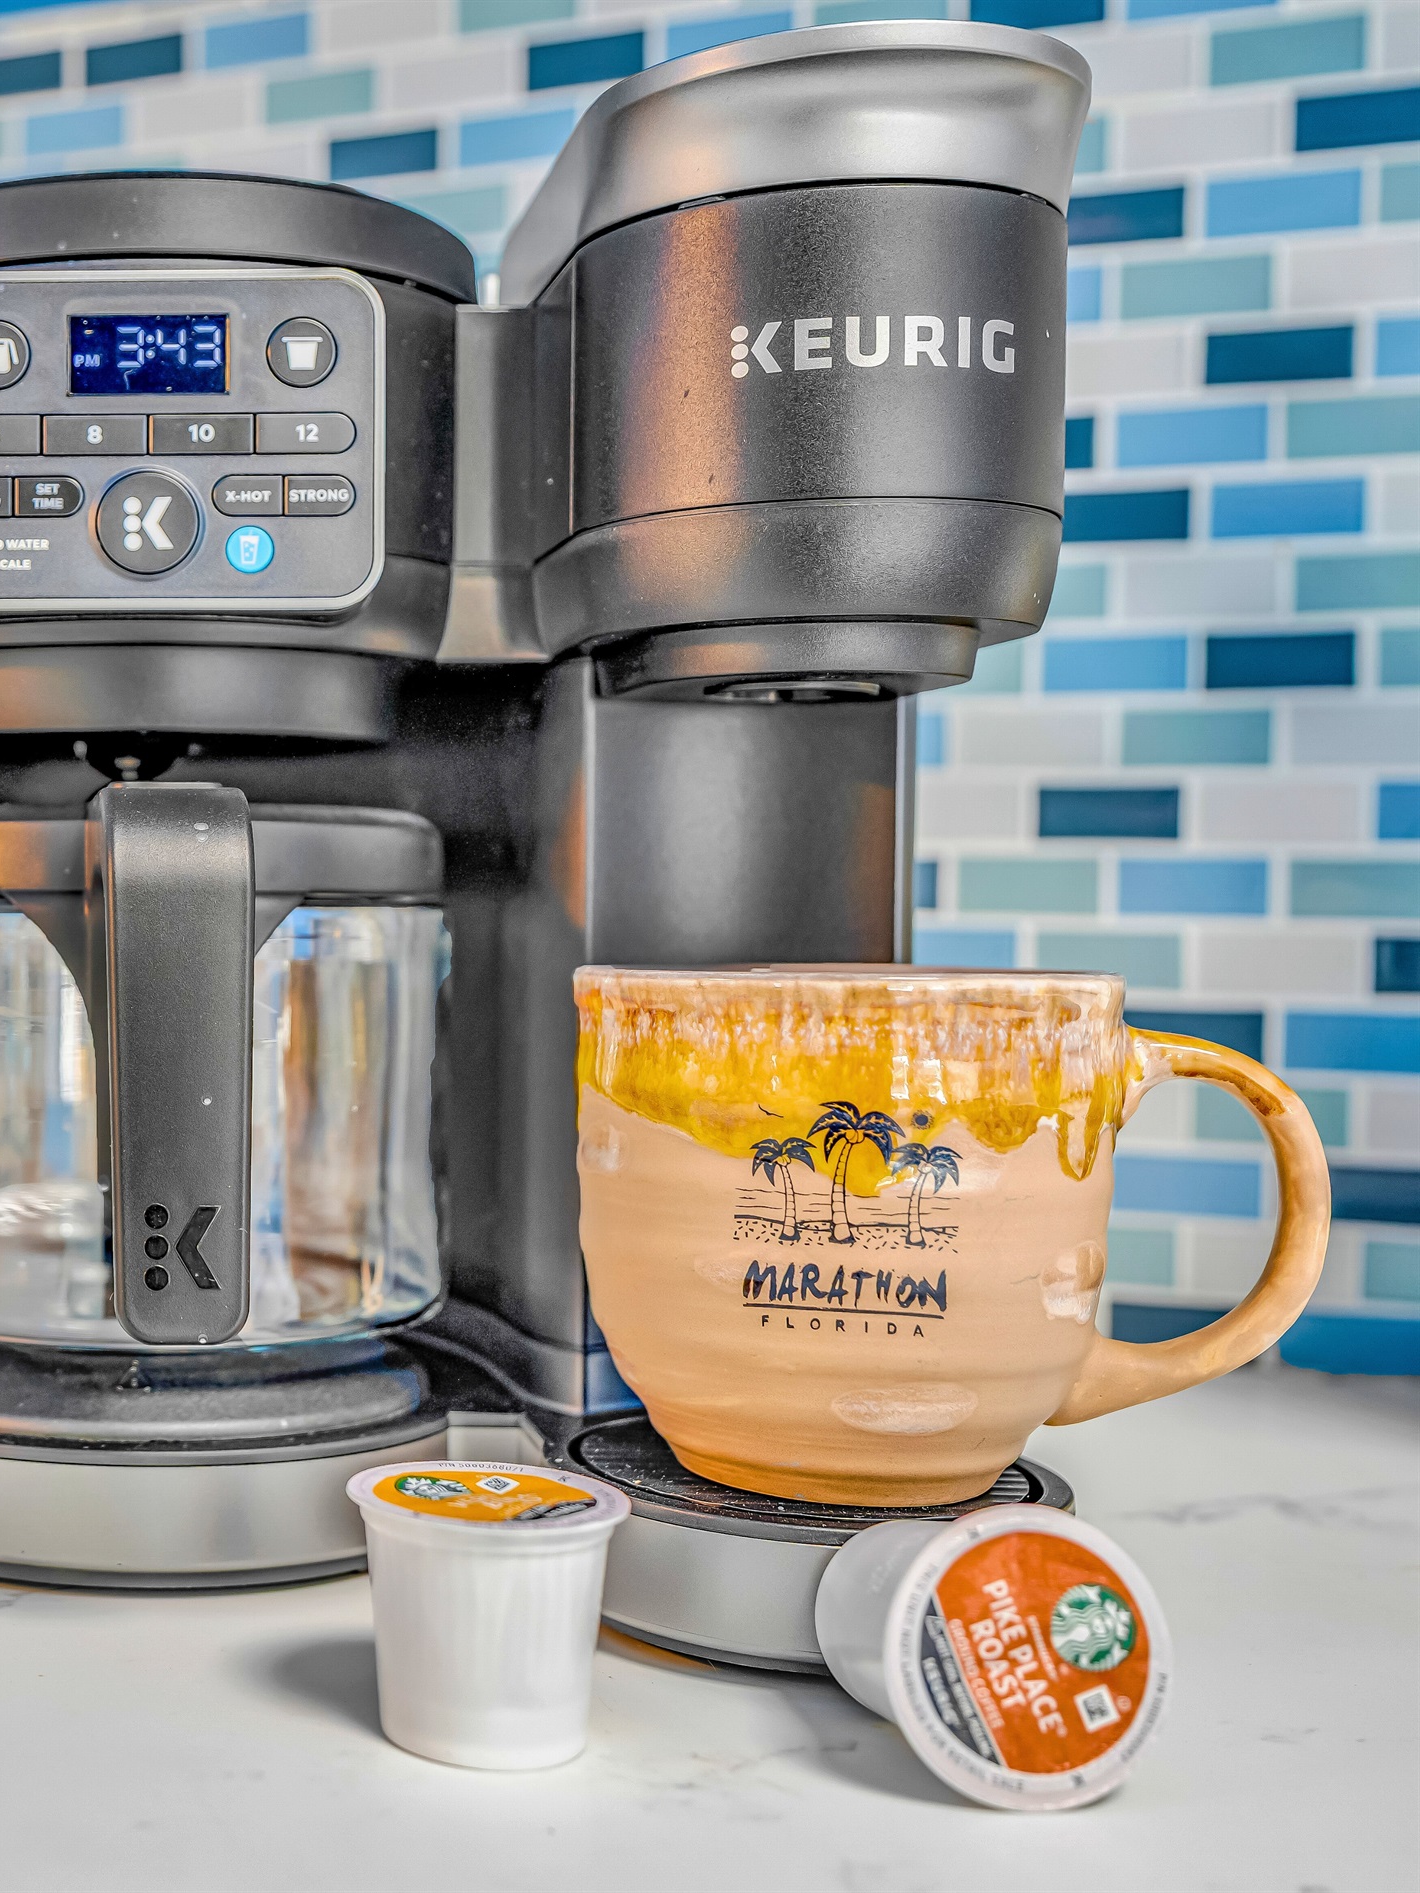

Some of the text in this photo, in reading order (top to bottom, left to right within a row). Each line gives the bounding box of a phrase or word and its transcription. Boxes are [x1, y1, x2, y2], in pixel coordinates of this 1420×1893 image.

[73, 326, 222, 368] PM 3:43
[730, 315, 1014, 378] KEURIG
[86, 425, 103, 444] 8
[188, 424, 216, 443] 10
[295, 423, 319, 443] 12
[36, 483, 60, 495] SET
[225, 490, 271, 503] X-HOT
[289, 488, 349, 503] STRONG
[32, 498, 64, 509] TIME
[5, 539, 50, 550] WATER
[743, 1260, 947, 1312] MARATHON
[761, 1315, 925, 1337] FLORIDA
[969, 1618, 1027, 1708] ROAST
[982, 1579, 1027, 1644] PIKE
[1008, 1644, 1059, 1733] PLACE
